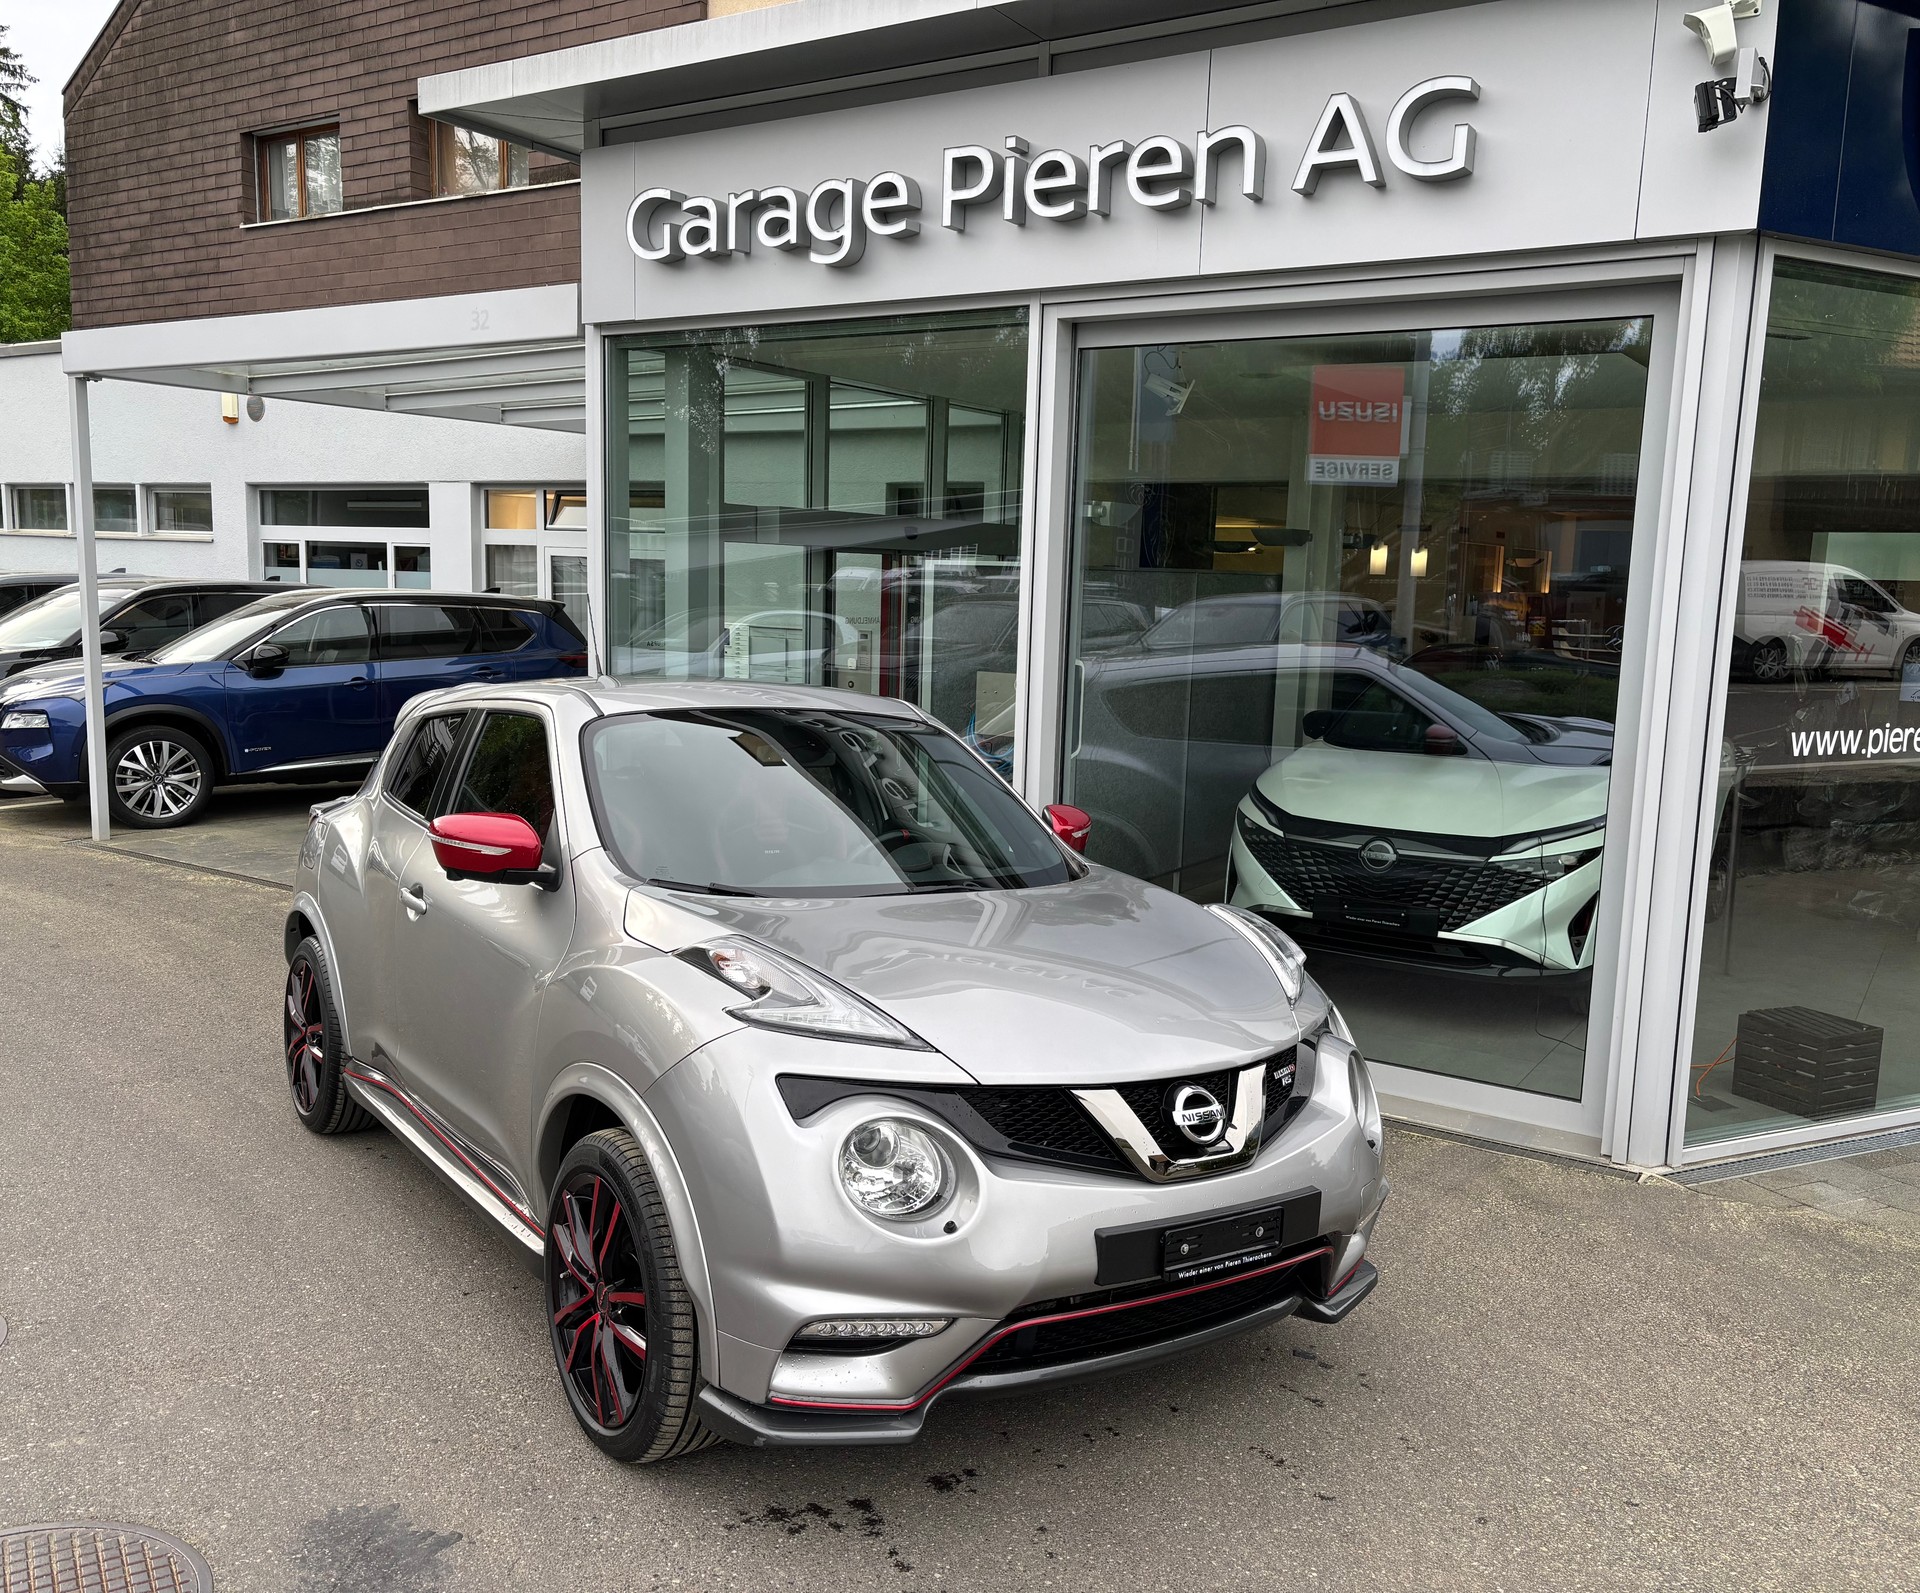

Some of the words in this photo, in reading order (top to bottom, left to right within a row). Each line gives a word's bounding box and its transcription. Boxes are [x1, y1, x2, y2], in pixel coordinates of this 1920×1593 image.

[625, 171, 922, 268] Garage
[941, 124, 1266, 231] Pieren
[1291, 75, 1480, 195] AG
[471, 309, 490, 331] 32
[1182, 1107, 1224, 1123] NISSAN
[1178, 1268, 1198, 1279] Wieder
[1199, 1266, 1213, 1274] einer
[1225, 1259, 1241, 1268] Pieren
